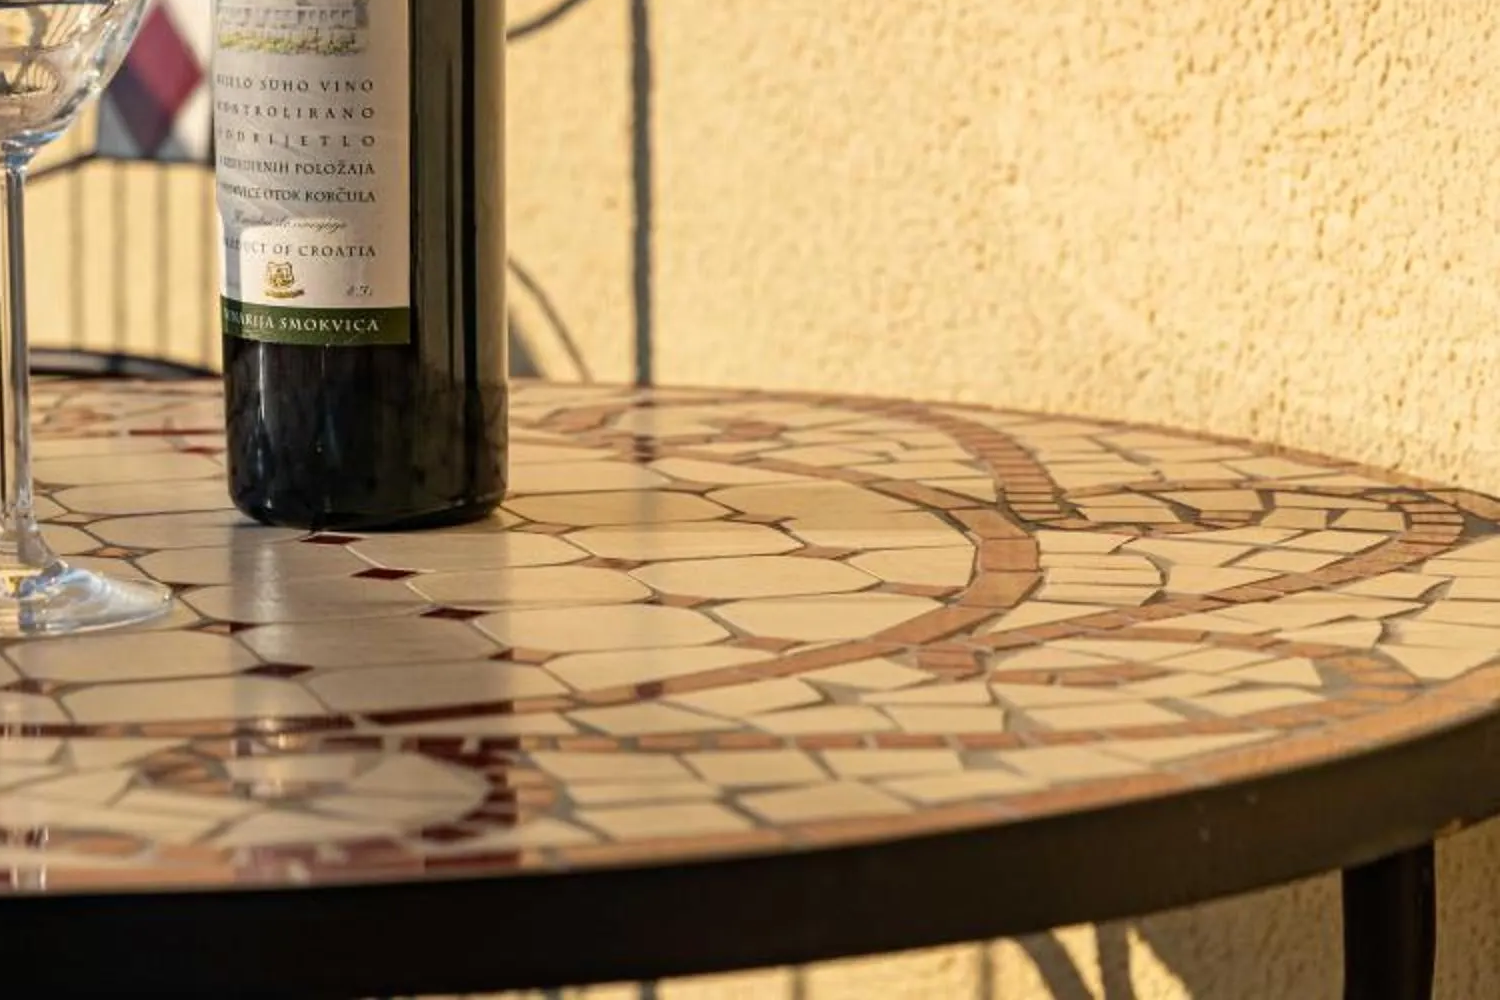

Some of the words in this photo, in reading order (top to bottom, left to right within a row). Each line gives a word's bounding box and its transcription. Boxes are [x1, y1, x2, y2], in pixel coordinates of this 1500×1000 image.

[259, 78, 309, 92] SUHO
[320, 78, 374, 93] VINO
[304, 186, 377, 203] KORČULA
[272, 243, 293, 254] OF
[298, 244, 377, 258] CROATIA
[278, 316, 381, 332] SMOKVICA
